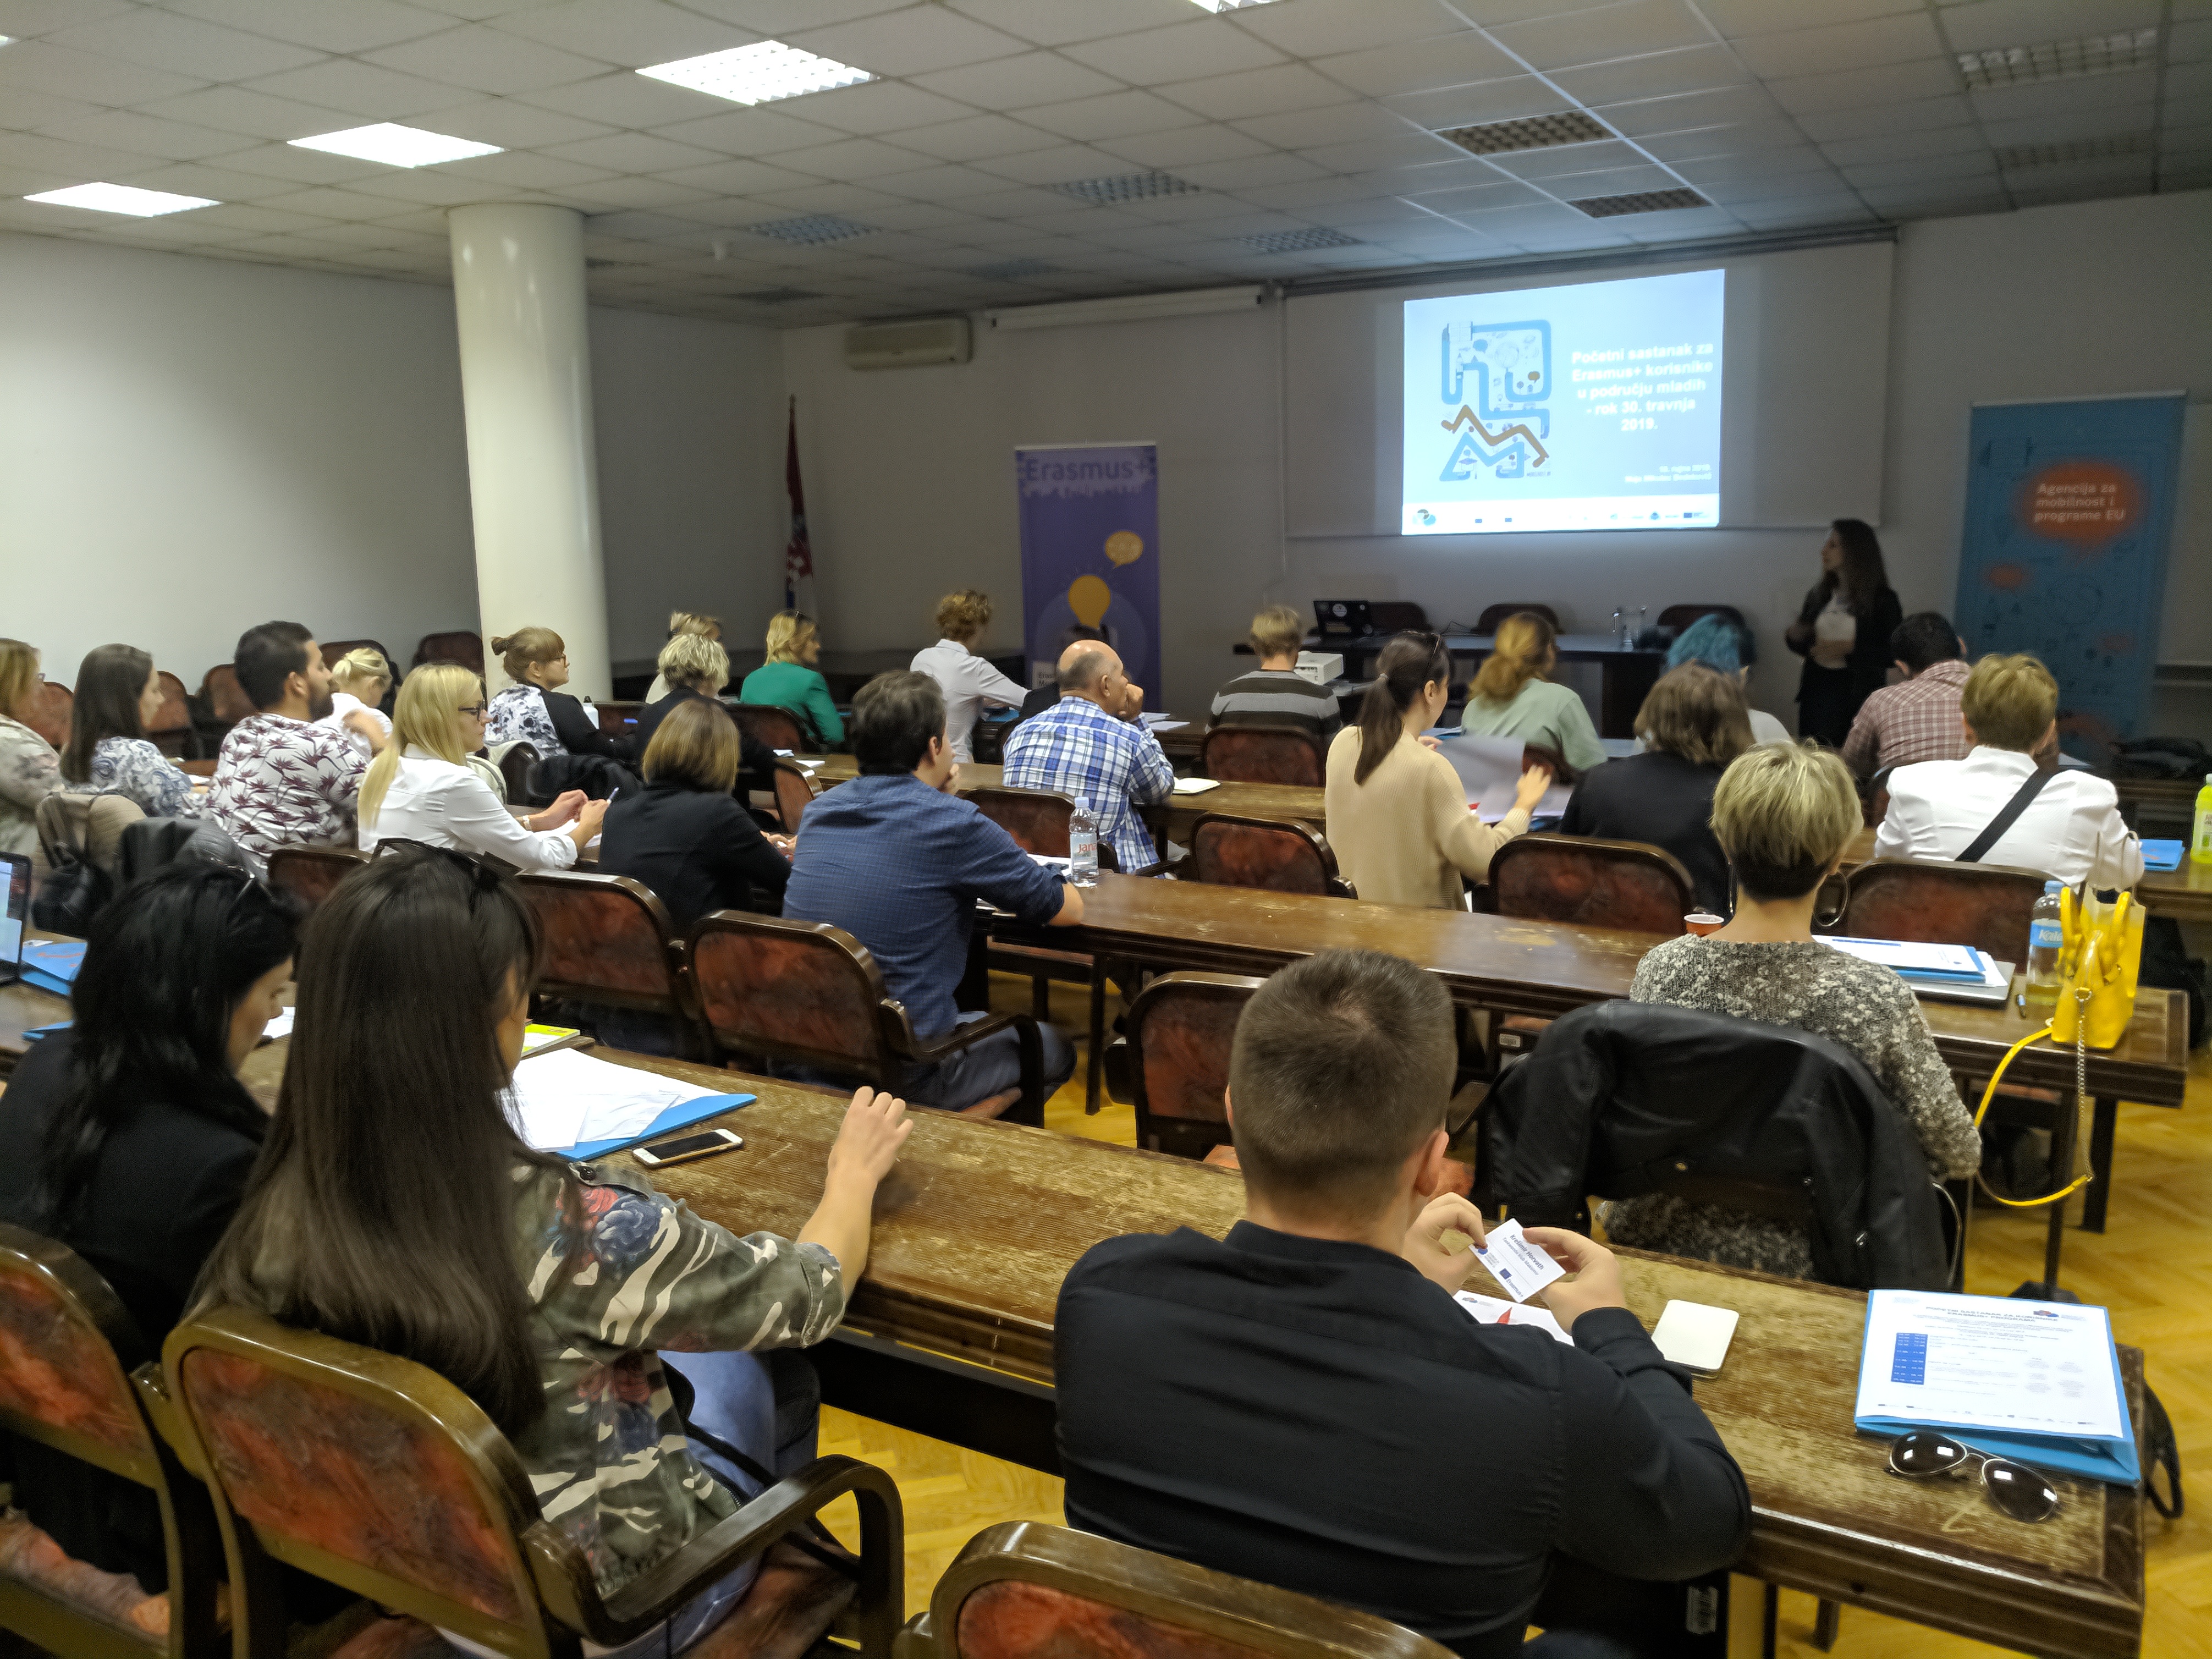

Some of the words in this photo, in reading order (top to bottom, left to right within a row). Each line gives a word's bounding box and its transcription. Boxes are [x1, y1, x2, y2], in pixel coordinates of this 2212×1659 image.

[1572, 348, 1624, 364] Početni
[1628, 343, 1692, 360] sastanak
[1696, 343, 1713, 355] za
[1572, 366, 1642, 382] Erasmus+
[1645, 360, 1713, 377] korisnike
[1577, 388, 1587, 398] u
[1589, 382, 1653, 401] području
[1656, 378, 1706, 394] mladih
[1595, 402, 1617, 415] rok
[1621, 400, 1643, 414] 30.
[1646, 397, 1696, 413] travnja
[1621, 418, 1658, 431] 2019.
[2038, 482, 2096, 496] Agencija
[2100, 485, 2116, 493] za
[2036, 496, 2105, 507] mobilnost
[2034, 512, 2101, 523] programe
[2106, 509, 2125, 520] EU
[1526, 1251, 1544, 1270] Horvath
[1506, 1278, 1523, 1297] Erasmus+
